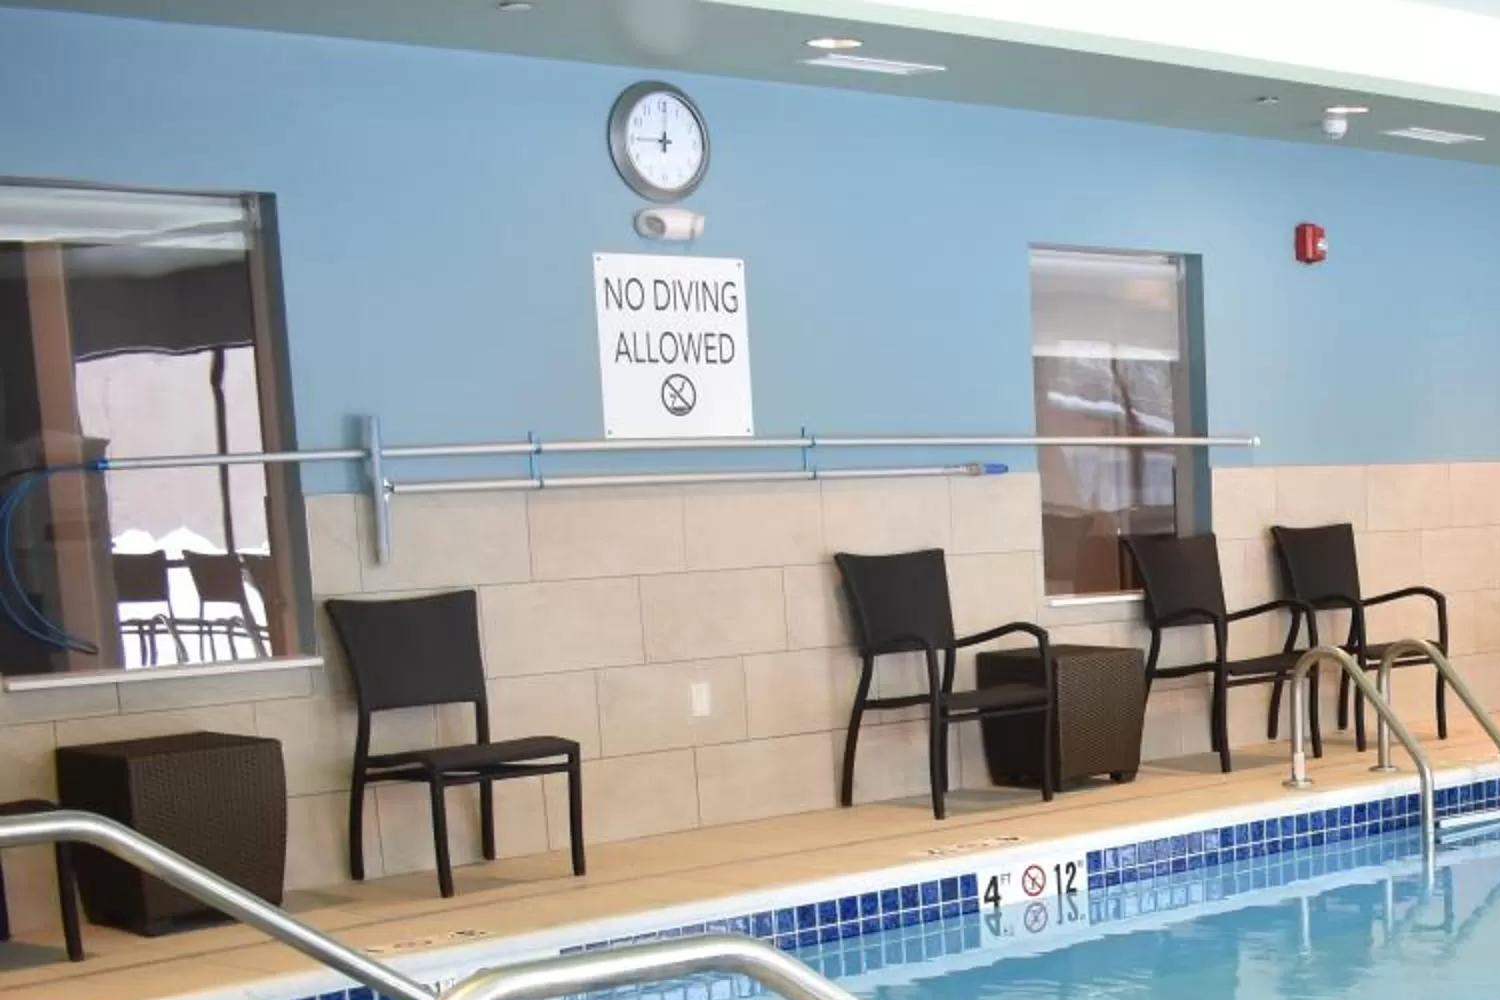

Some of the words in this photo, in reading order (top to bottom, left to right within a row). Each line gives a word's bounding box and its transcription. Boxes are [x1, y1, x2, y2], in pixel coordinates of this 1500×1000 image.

[605, 278, 645, 311] NO
[654, 279, 739, 313] DIVING
[615, 331, 735, 364] ALLOWED
[984, 875, 1001, 909] 4
